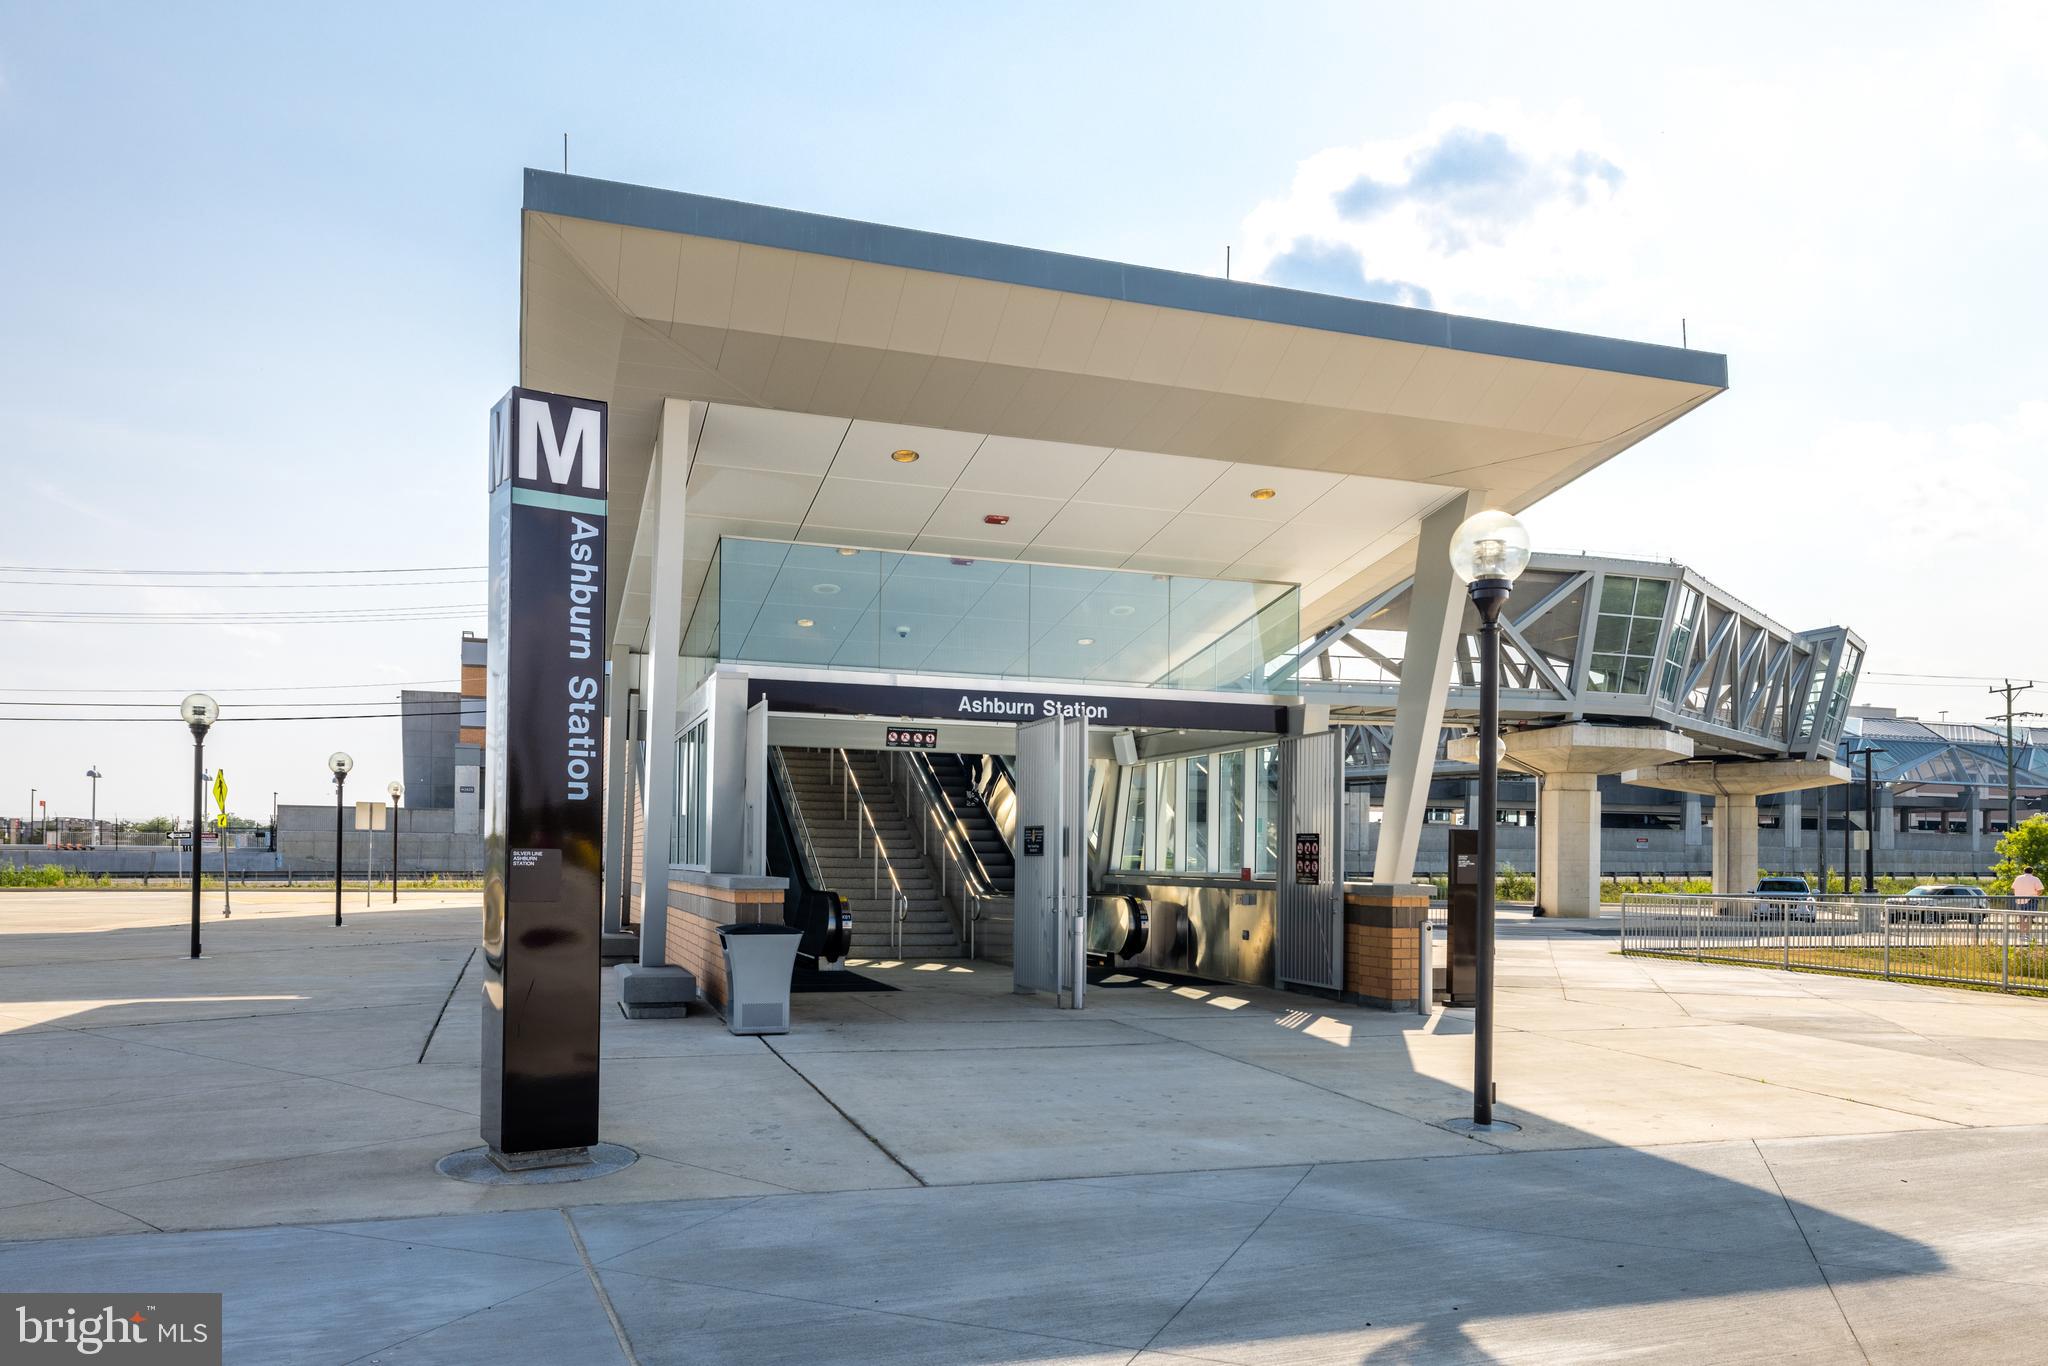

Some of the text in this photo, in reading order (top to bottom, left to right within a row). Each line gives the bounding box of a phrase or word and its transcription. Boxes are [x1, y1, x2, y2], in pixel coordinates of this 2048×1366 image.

[518, 397, 601, 490] M
[567, 516, 599, 800] Ashburn Station
[958, 695, 1108, 718] Ashburn Station
